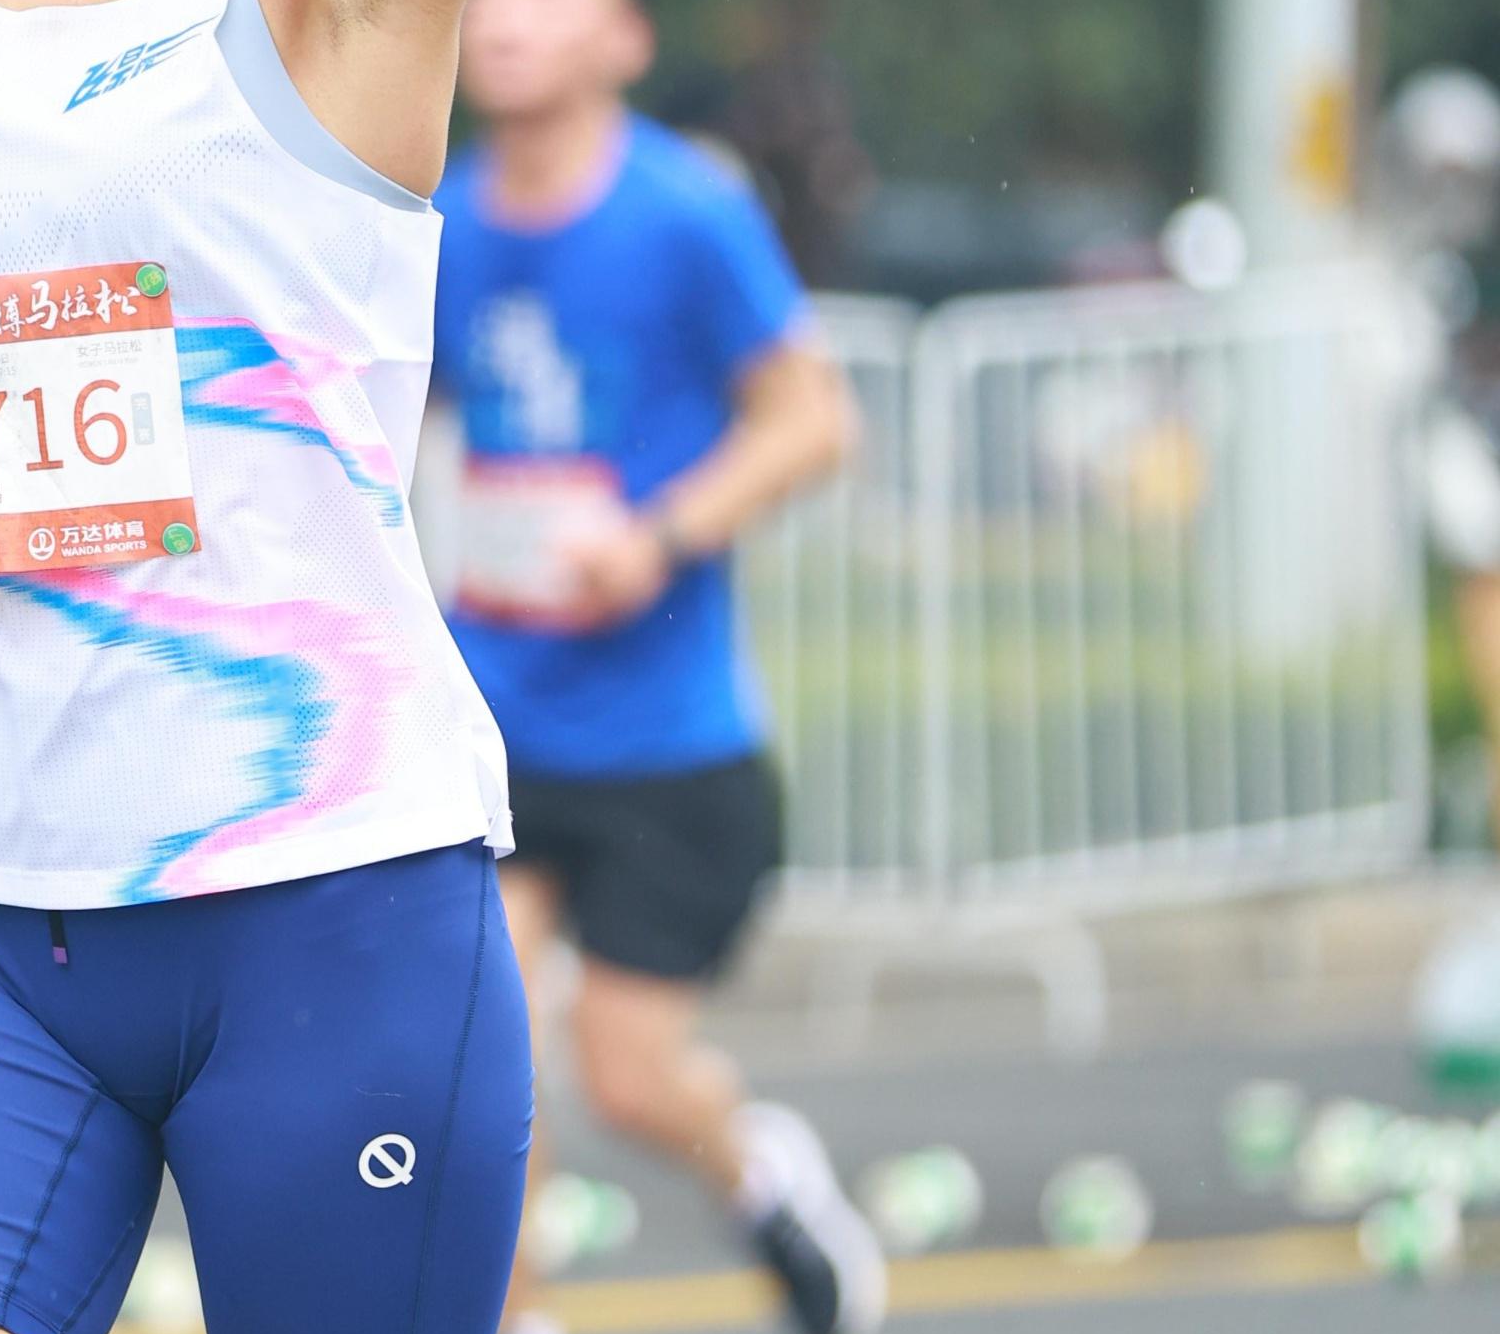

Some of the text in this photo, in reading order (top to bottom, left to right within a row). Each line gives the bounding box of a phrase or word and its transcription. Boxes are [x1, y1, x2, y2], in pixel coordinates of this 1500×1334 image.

[60, 520, 145, 545] 万达体育
[60, 539, 148, 558] WANDA SPORTS
